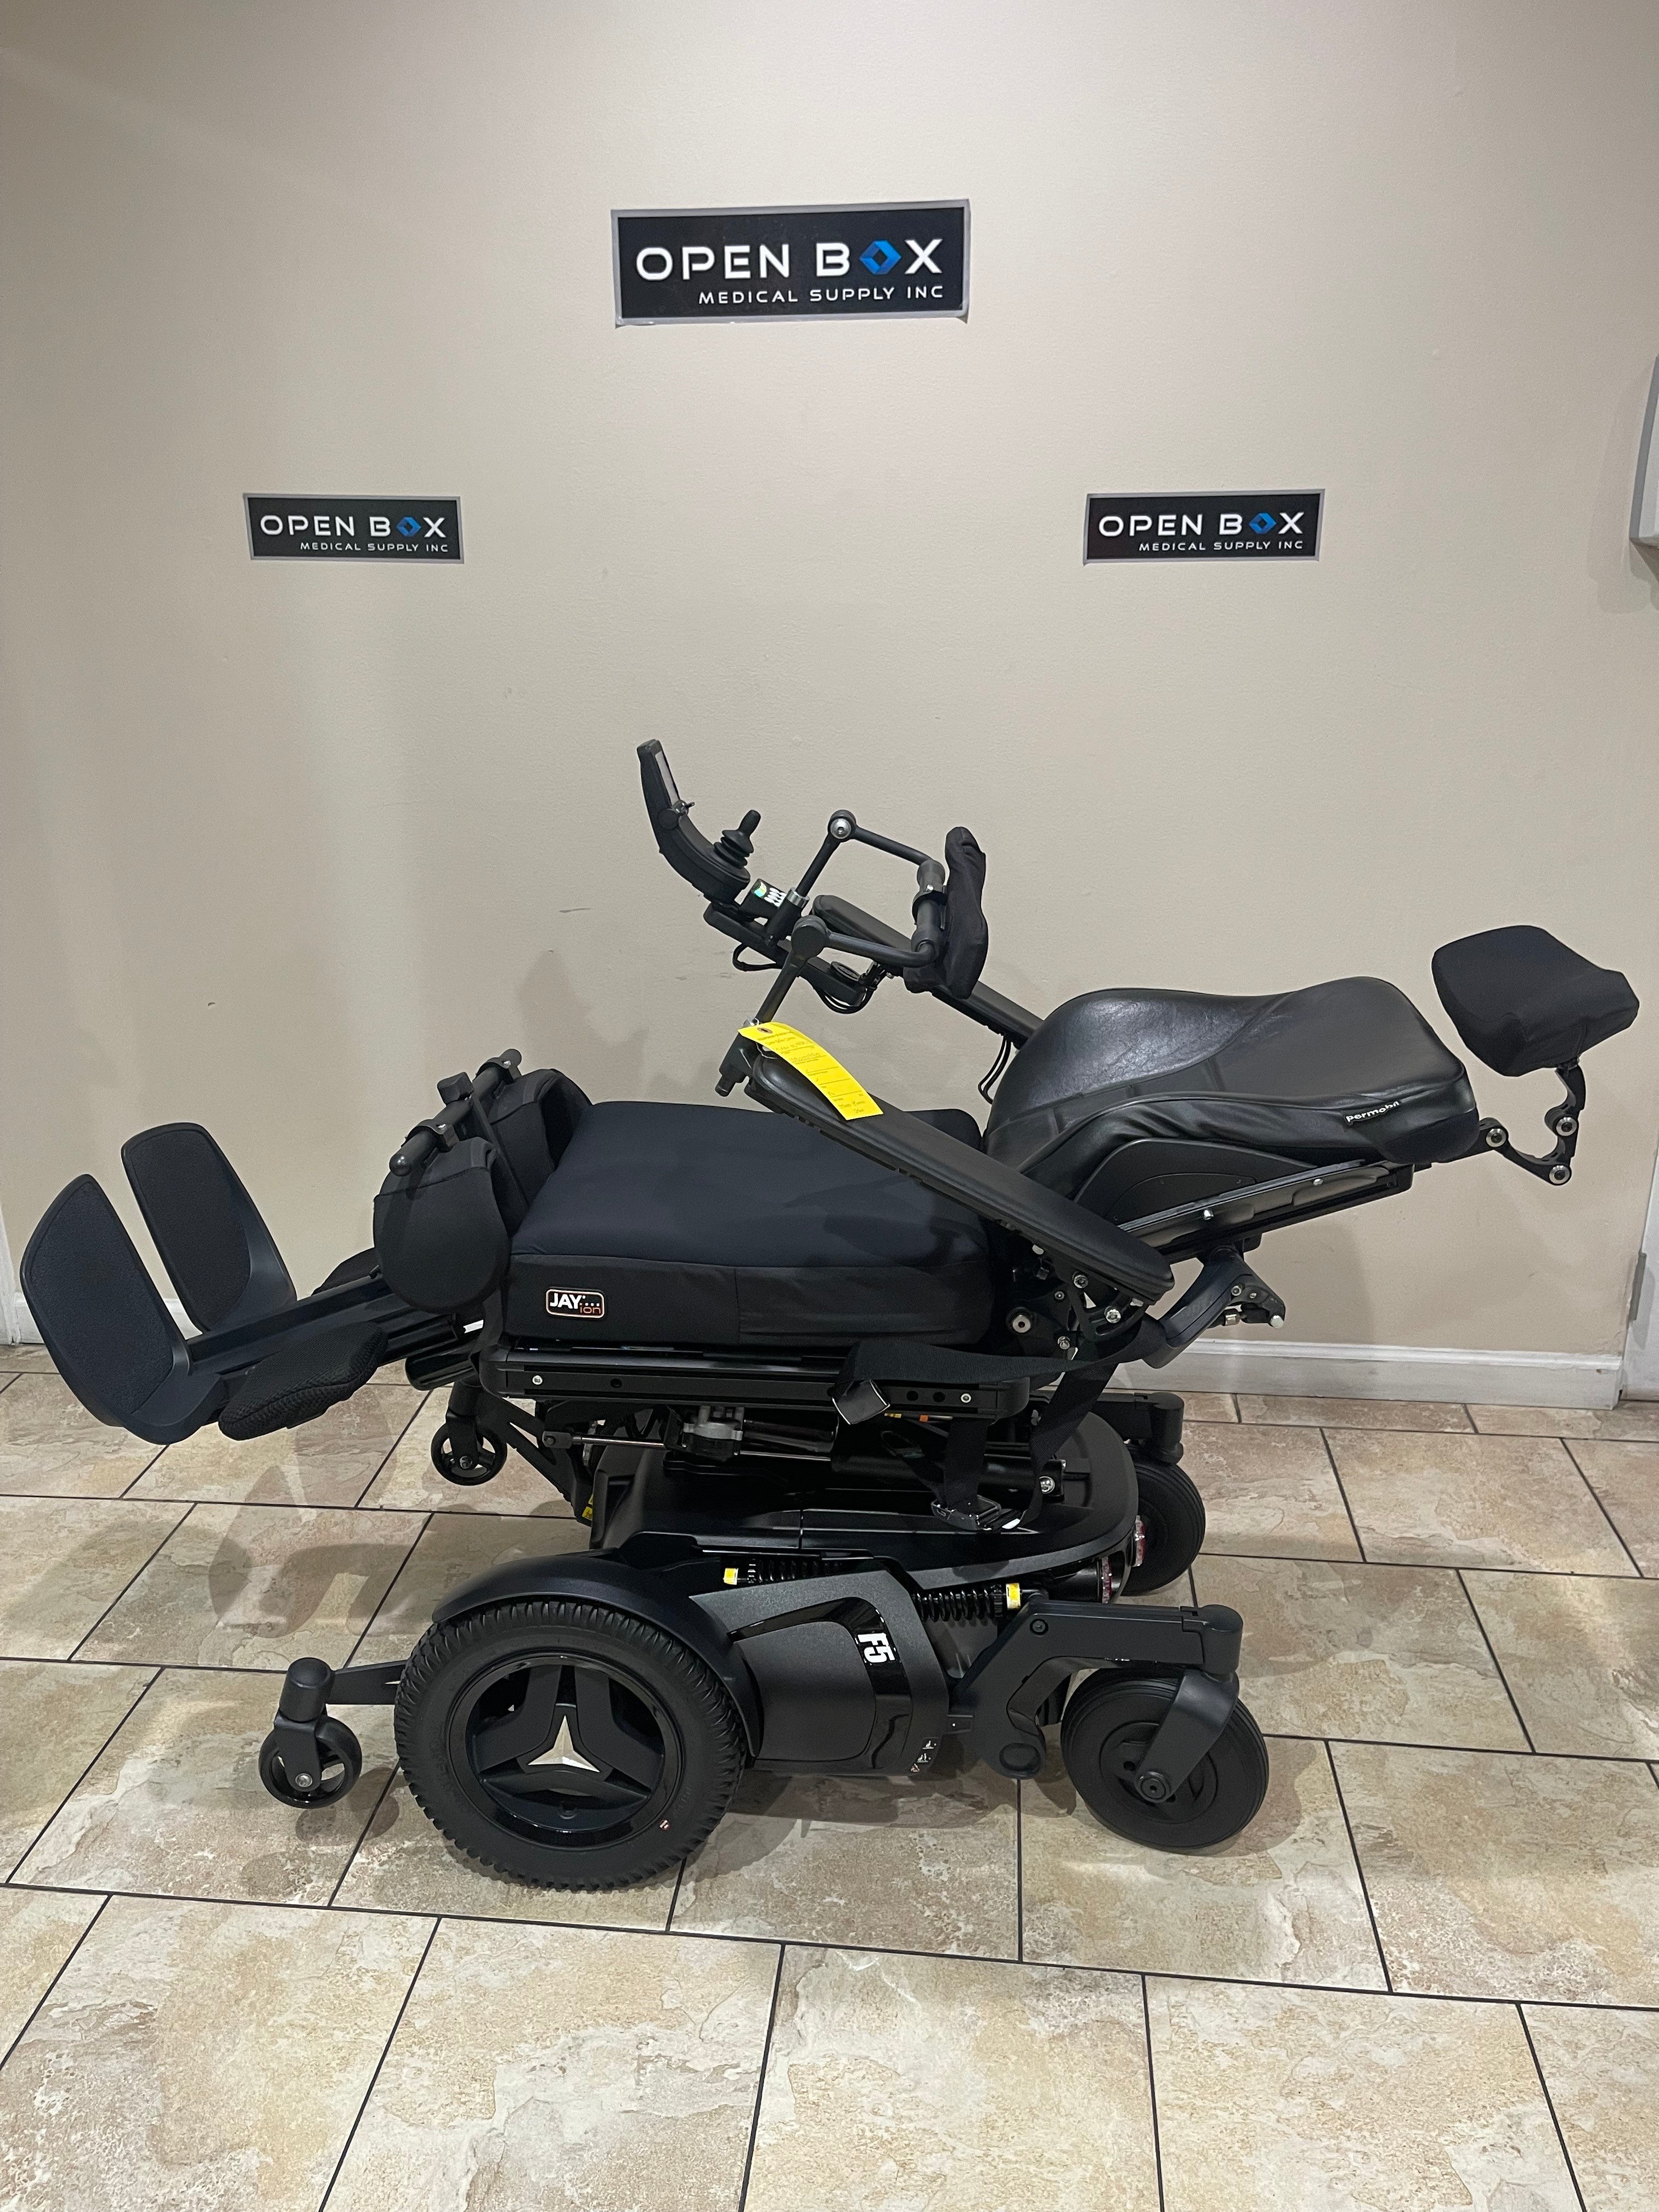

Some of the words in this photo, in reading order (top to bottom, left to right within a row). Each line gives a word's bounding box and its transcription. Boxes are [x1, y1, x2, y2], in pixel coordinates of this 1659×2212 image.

[635, 243, 789, 281] OPEN
[816, 238, 943, 277] BOX
[698, 290, 798, 305] MEDICAL
[809, 286, 895, 302] SUPPLY
[907, 285, 944, 299] INC
[259, 515, 355, 537] OPEN
[369, 516, 447, 538] BOX
[1098, 513, 1203, 537] OPEN
[1218, 511, 1305, 535] BOX
[300, 541, 362, 551] MEDICAL
[367, 543, 419, 552] SUPPLY
[426, 544, 448, 552] INC
[1138, 542, 1206, 551] MEDICAL
[1213, 541, 1271, 550] SUPPLY
[1278, 540, 1304, 550] INC
[550, 1293, 583, 1310] JAY
[579, 1302, 601, 1314] ion
[857, 1632, 895, 1663] F5
